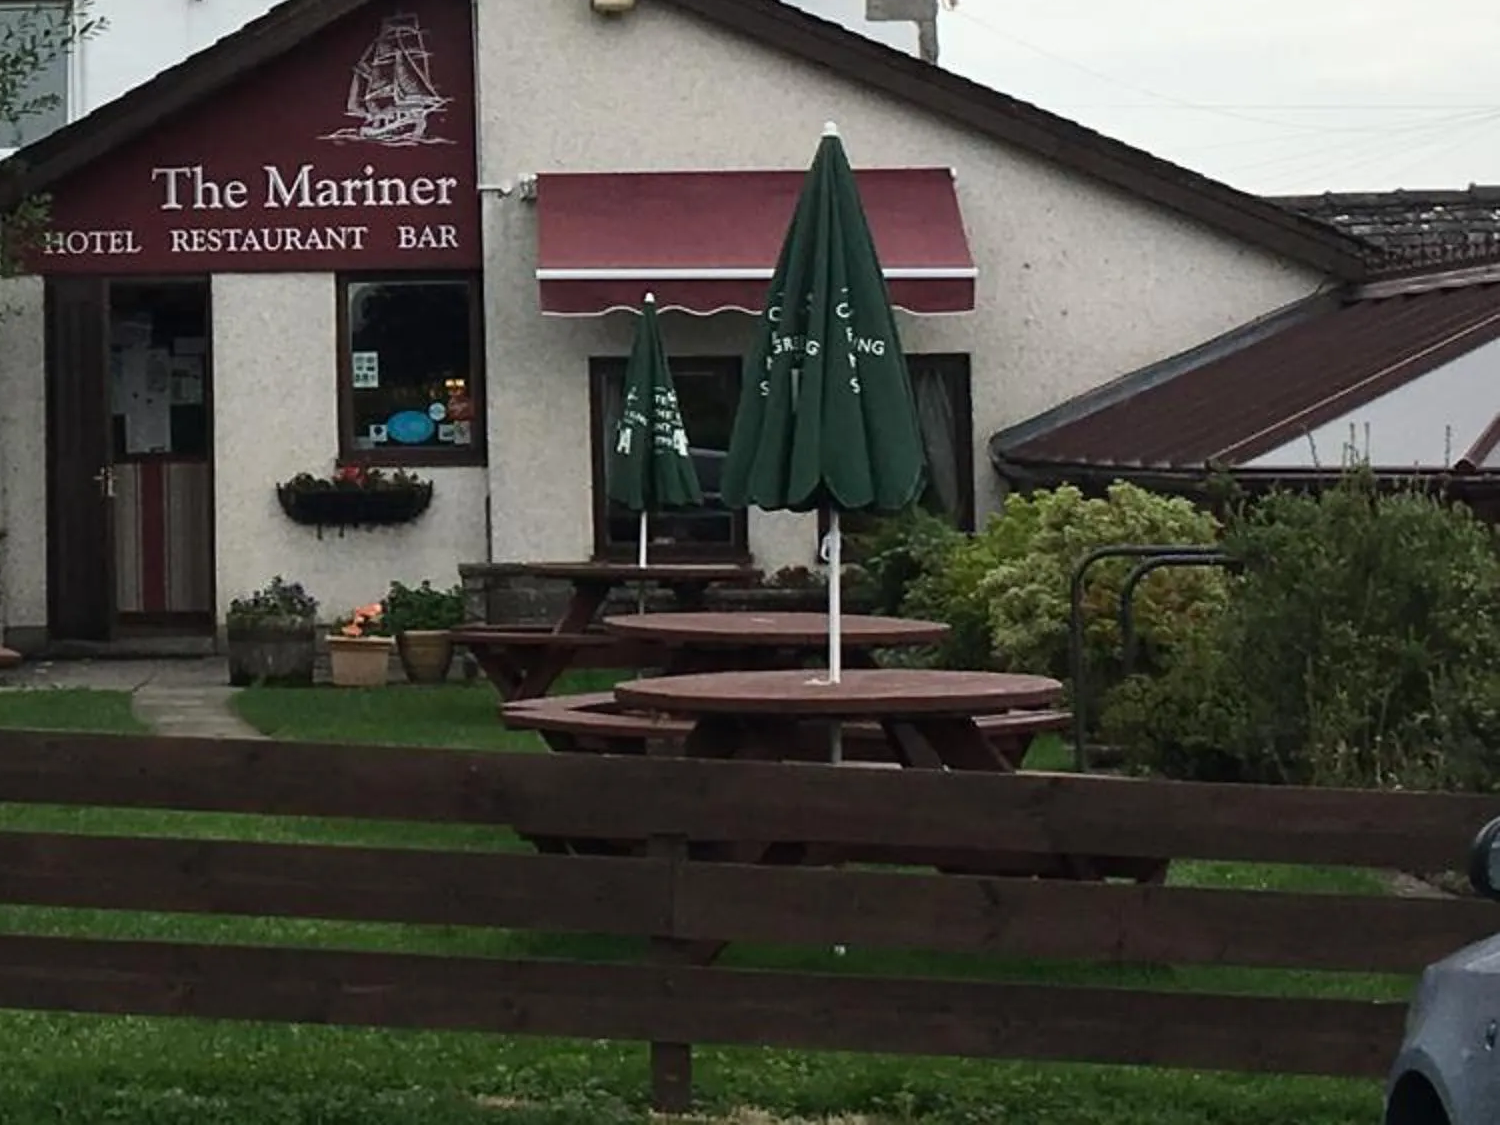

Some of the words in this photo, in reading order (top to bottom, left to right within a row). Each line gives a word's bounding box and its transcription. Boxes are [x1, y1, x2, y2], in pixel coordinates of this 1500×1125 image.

[152, 165, 248, 210] The
[263, 164, 457, 208] Mariner
[44, 230, 141, 255] HOTEL
[171, 227, 369, 253] RESTAURANT
[398, 225, 459, 249] BAR
